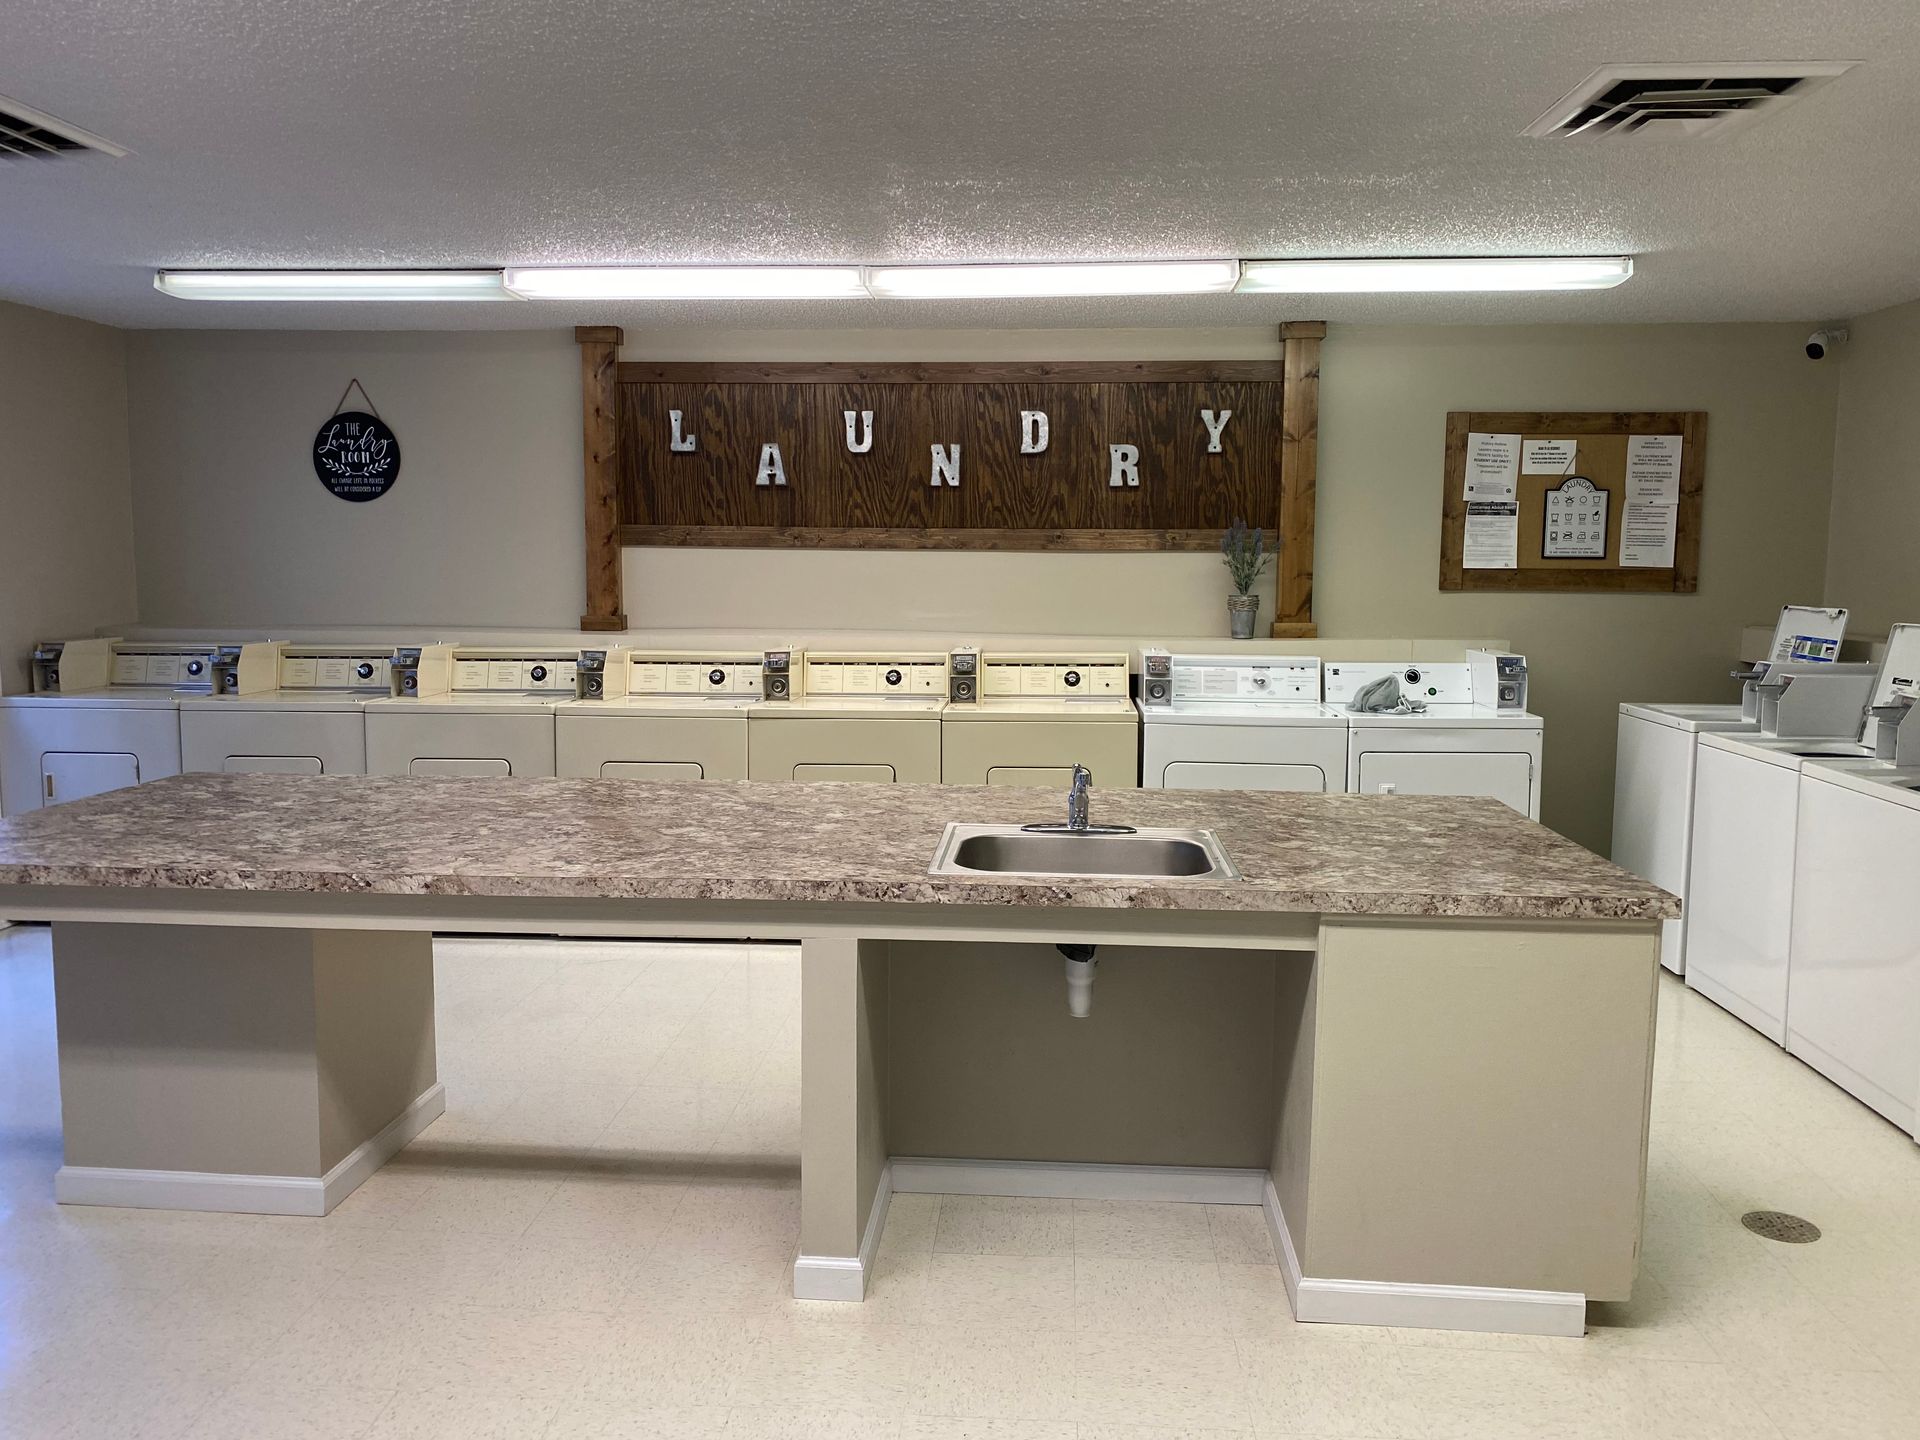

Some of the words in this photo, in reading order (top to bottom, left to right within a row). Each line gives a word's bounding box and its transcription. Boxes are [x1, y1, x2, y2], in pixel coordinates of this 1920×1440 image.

[345, 422, 361, 436] THE
[318, 424, 393, 459] Laundry
[669, 409, 1232, 488] LAUNDRY
[341, 451, 370, 464] ROOM
[1562, 479, 1595, 494] LAUNDRY
